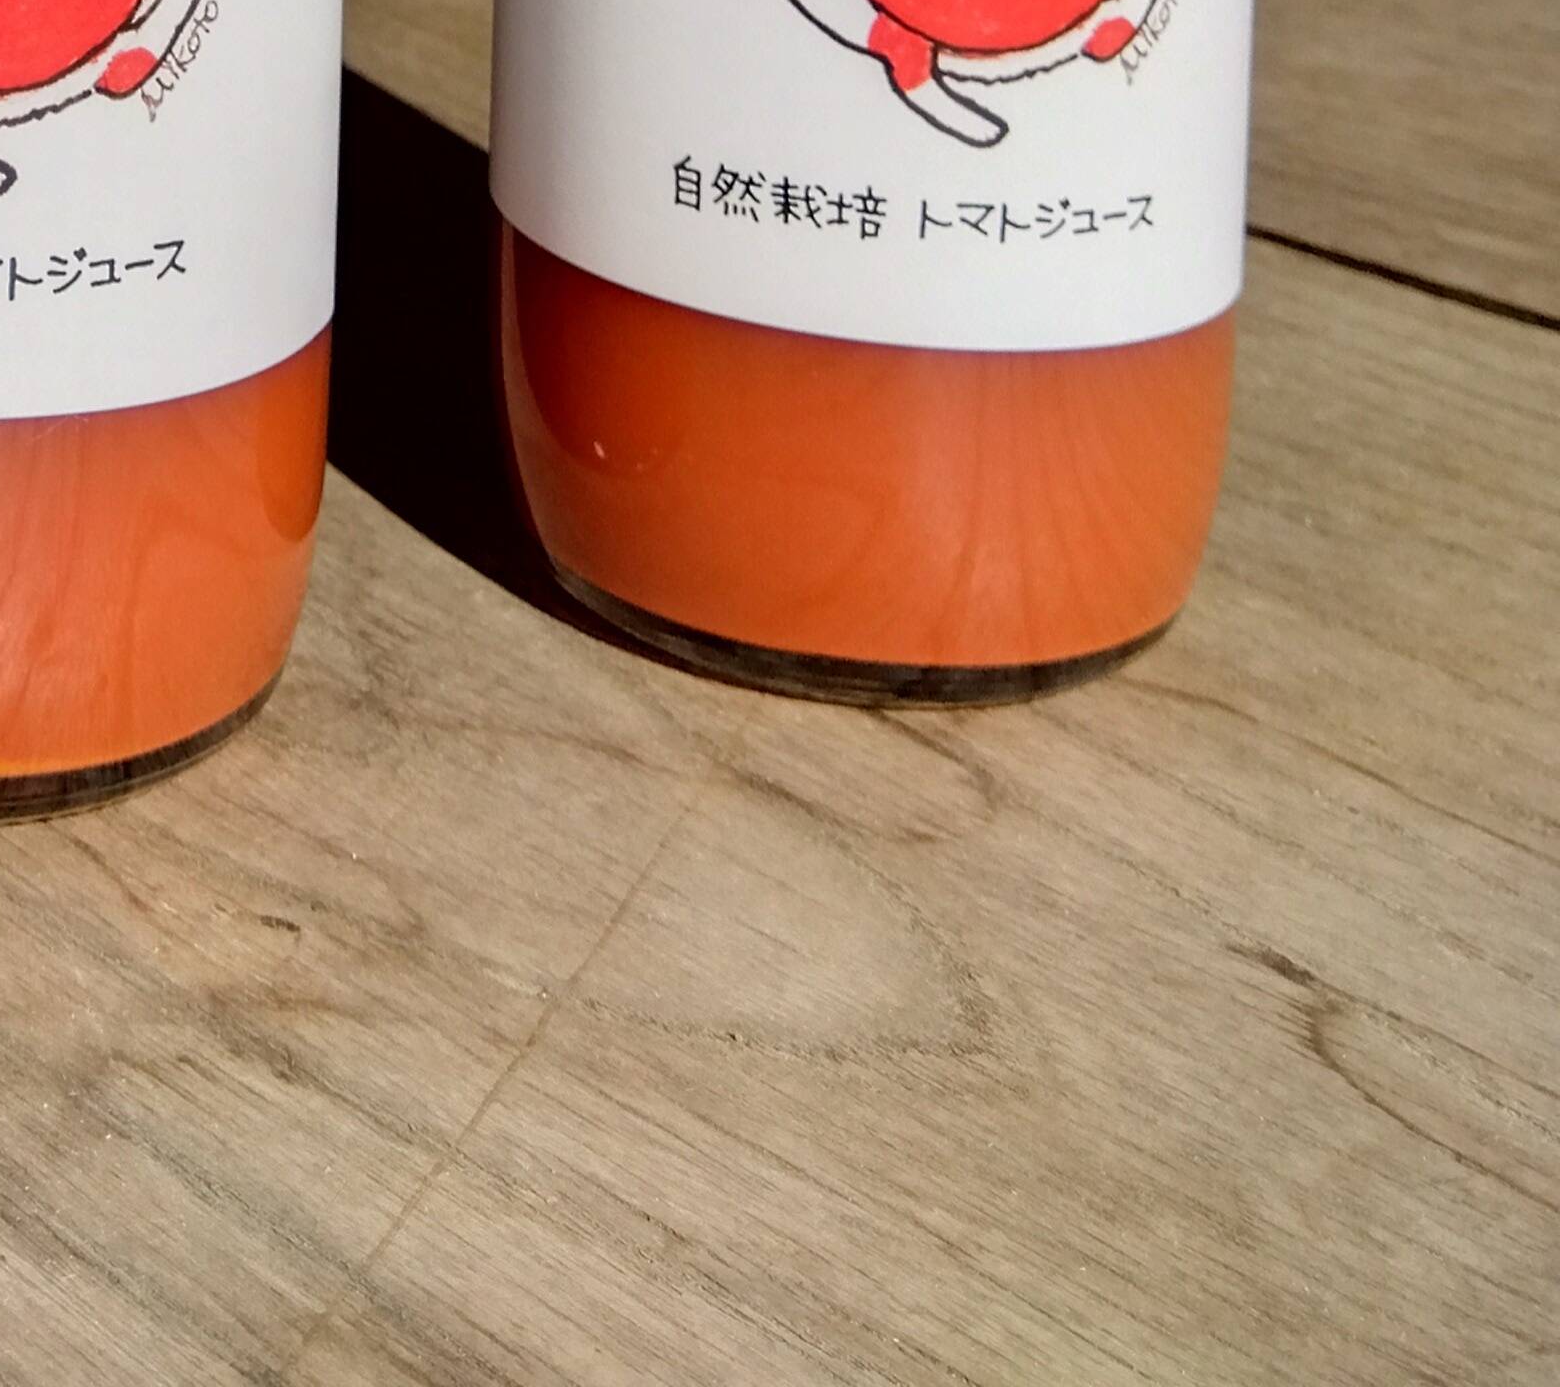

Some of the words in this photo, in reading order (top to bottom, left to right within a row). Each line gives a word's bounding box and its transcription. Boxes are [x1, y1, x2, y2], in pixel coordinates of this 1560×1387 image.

[672, 154, 888, 241] 自然栽培
[919, 193, 1155, 244] トマトジュース
